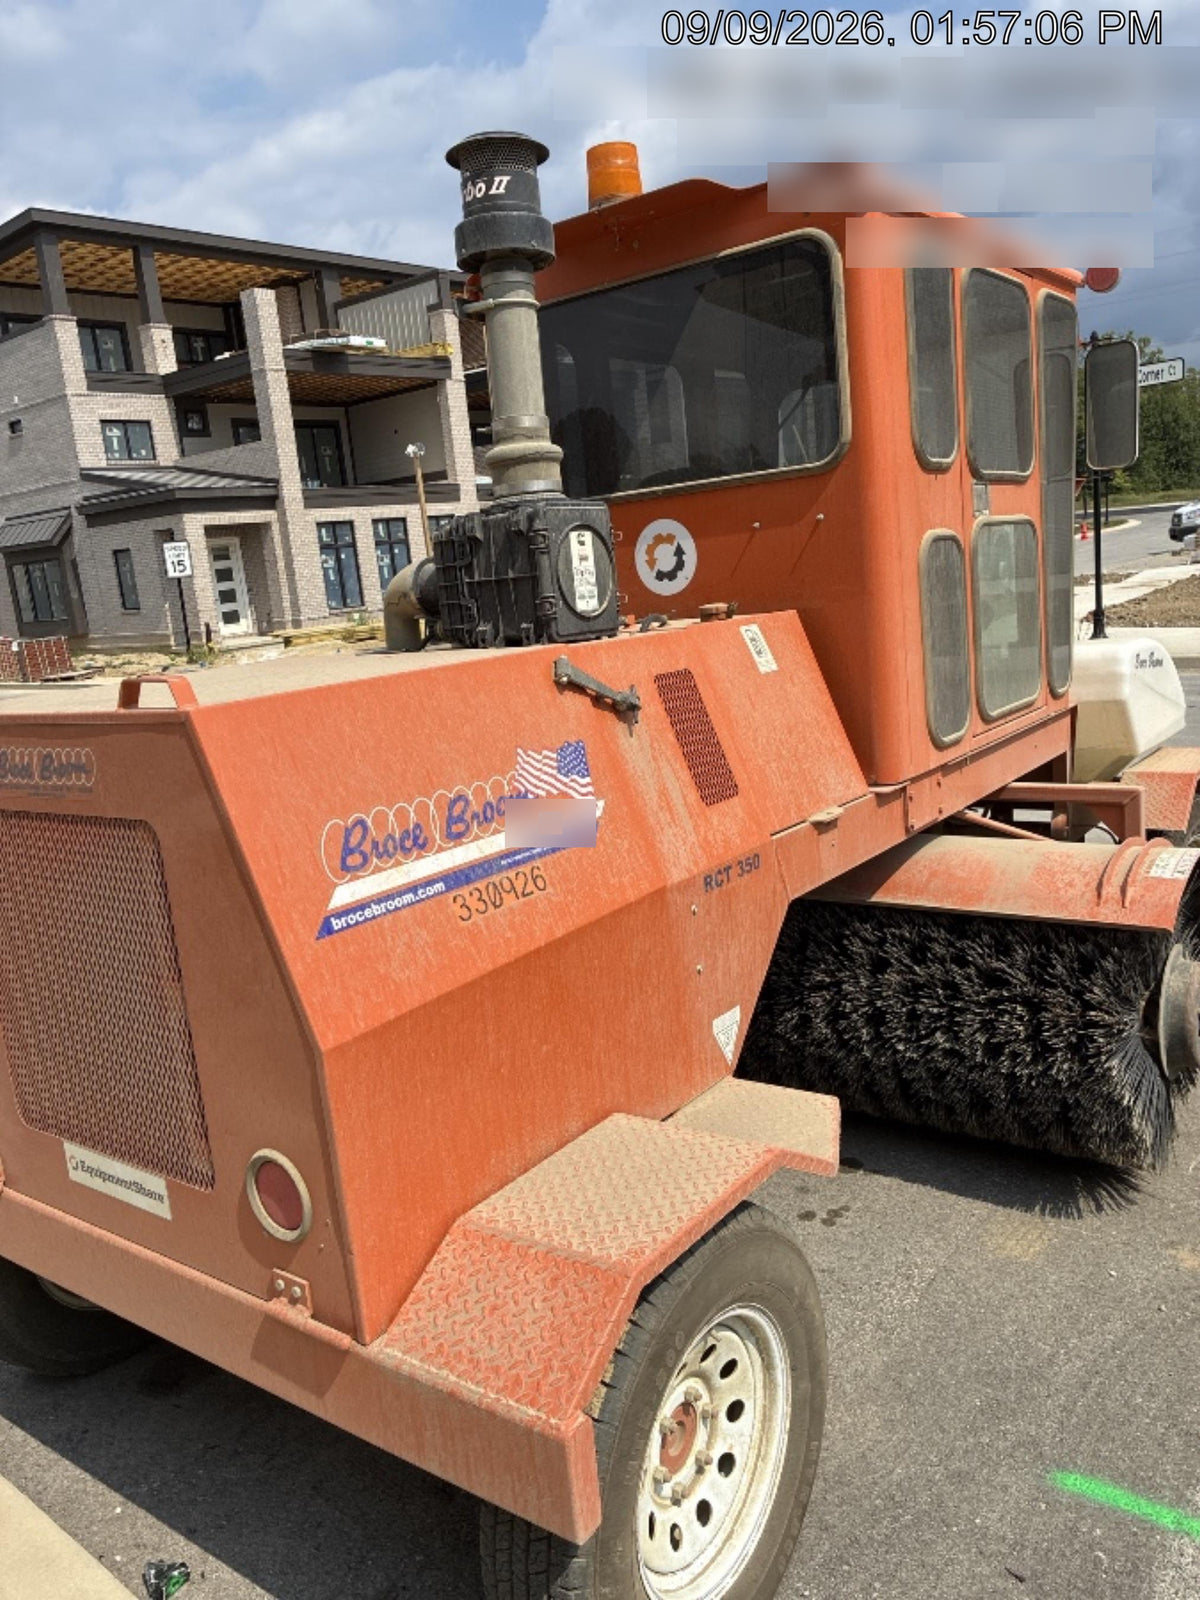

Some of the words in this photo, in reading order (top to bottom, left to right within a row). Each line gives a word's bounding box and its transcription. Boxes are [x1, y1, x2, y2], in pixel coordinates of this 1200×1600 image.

[488, 175, 512, 195] II
[171, 559, 187, 573] 15
[340, 817, 429, 873] Broce
[452, 866, 548, 922] 330926
[704, 864, 732, 893] RCT
[737, 853, 760, 877] 350
[330, 880, 446, 931] brocebroom.com
[79, 1160, 165, 1204] EquipmentShare
